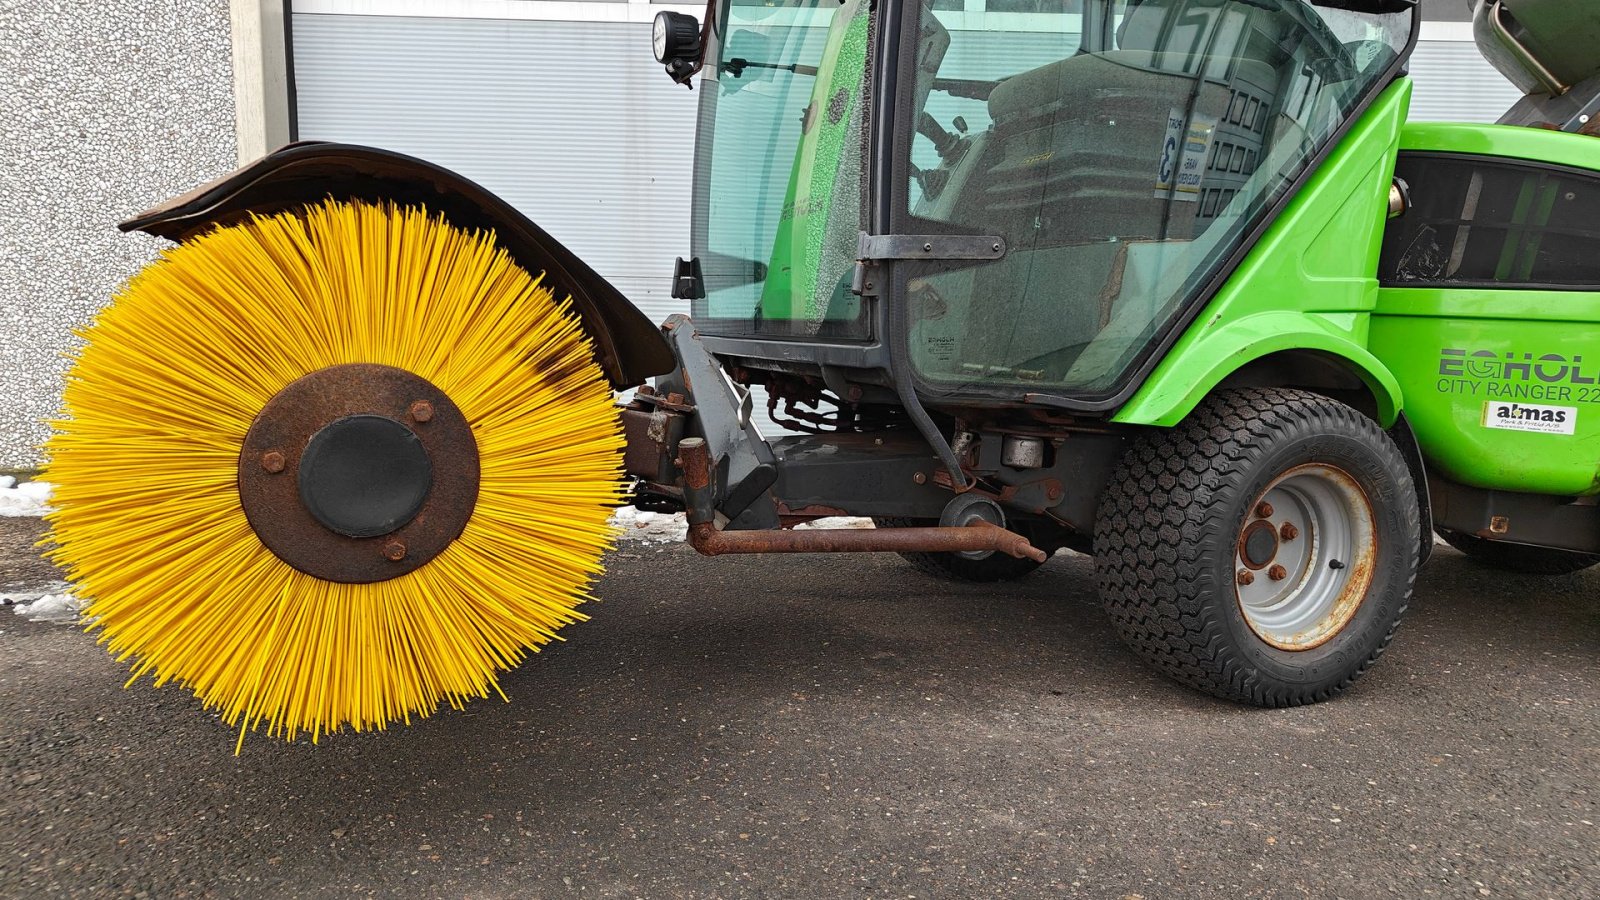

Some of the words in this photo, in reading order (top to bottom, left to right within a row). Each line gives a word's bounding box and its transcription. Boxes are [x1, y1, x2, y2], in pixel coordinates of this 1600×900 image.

[1439, 348, 1600, 384] EGHOL
[1437, 378, 1482, 395] CITY
[1487, 382, 1571, 402] RANGER
[1496, 403, 1566, 423] almas
